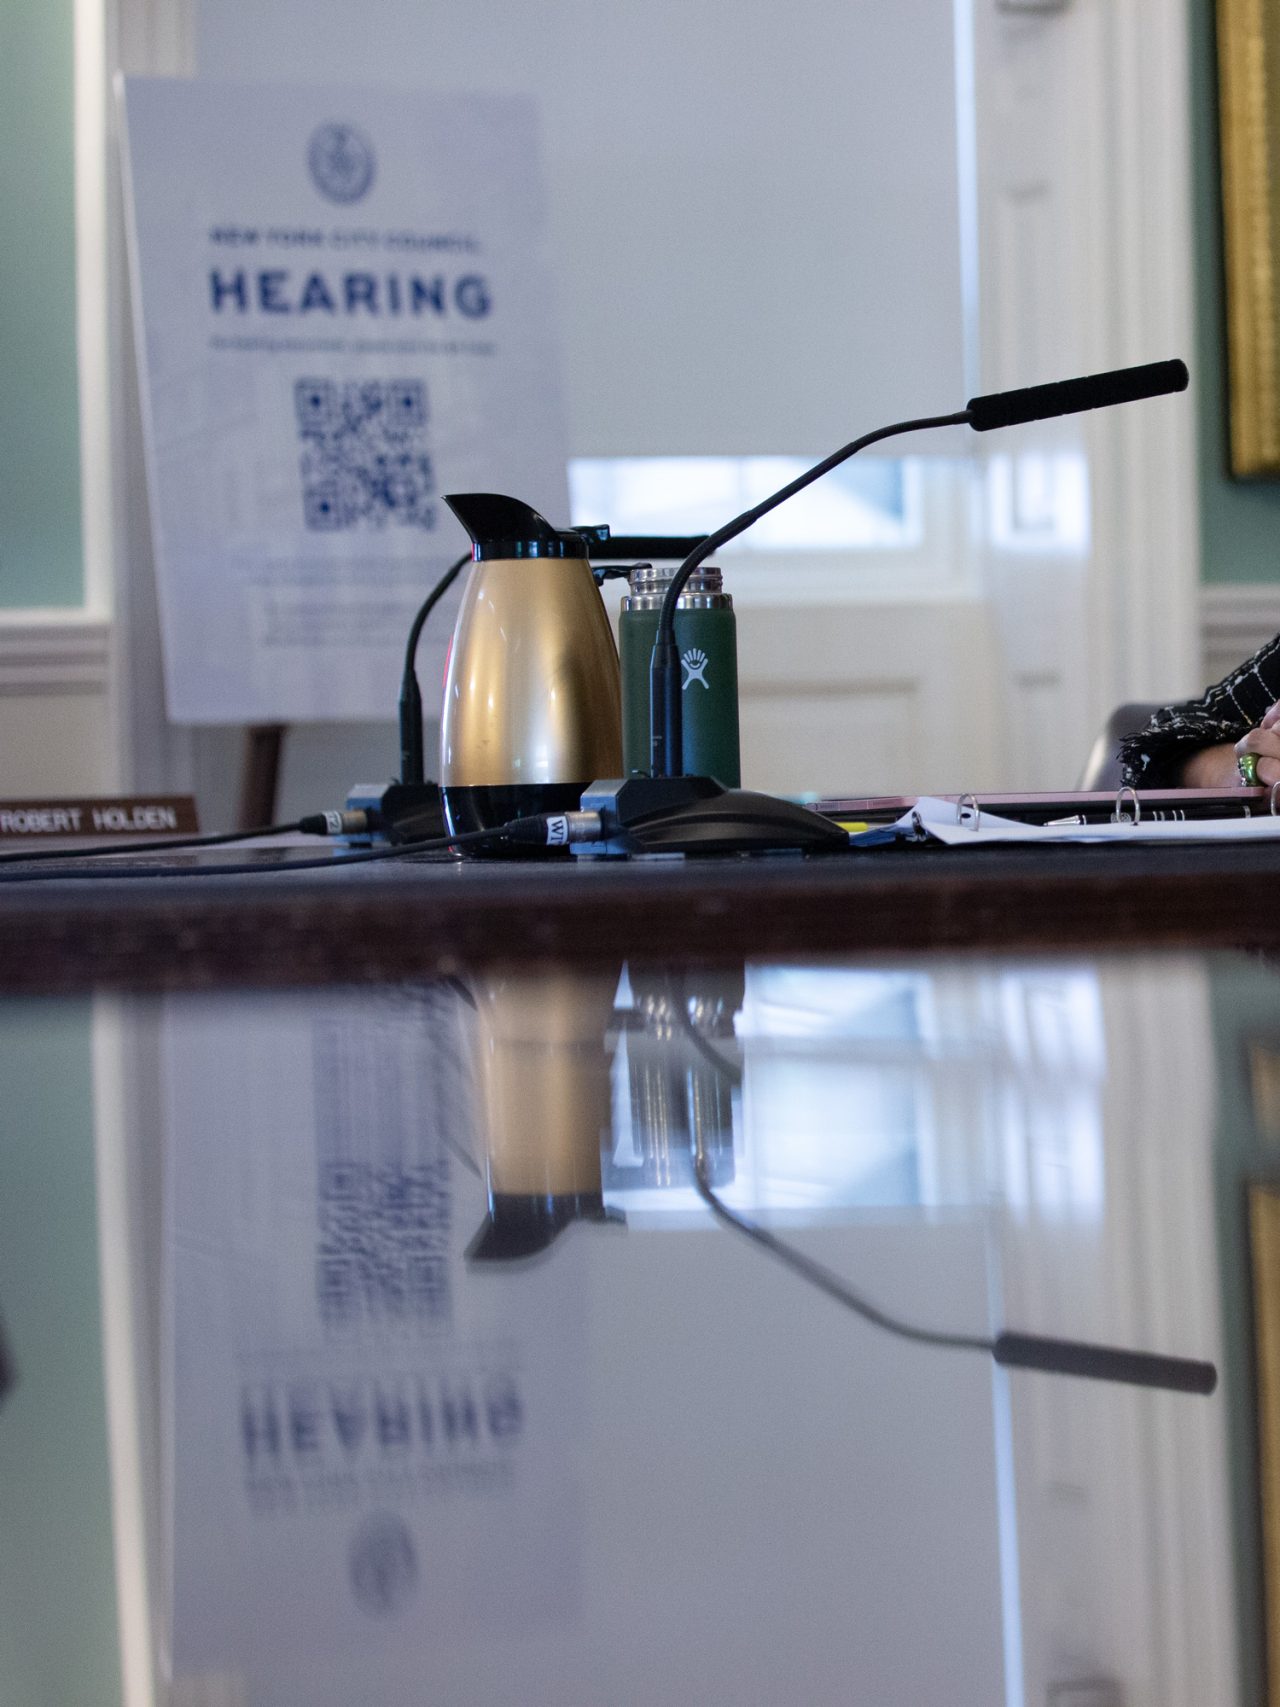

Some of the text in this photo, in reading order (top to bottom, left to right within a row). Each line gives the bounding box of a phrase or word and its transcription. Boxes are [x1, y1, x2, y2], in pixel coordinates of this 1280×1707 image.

[211, 227, 260, 247] NEW
[210, 268, 492, 319] HEARING
[0, 806, 178, 834] ROBERT HOLDEN
